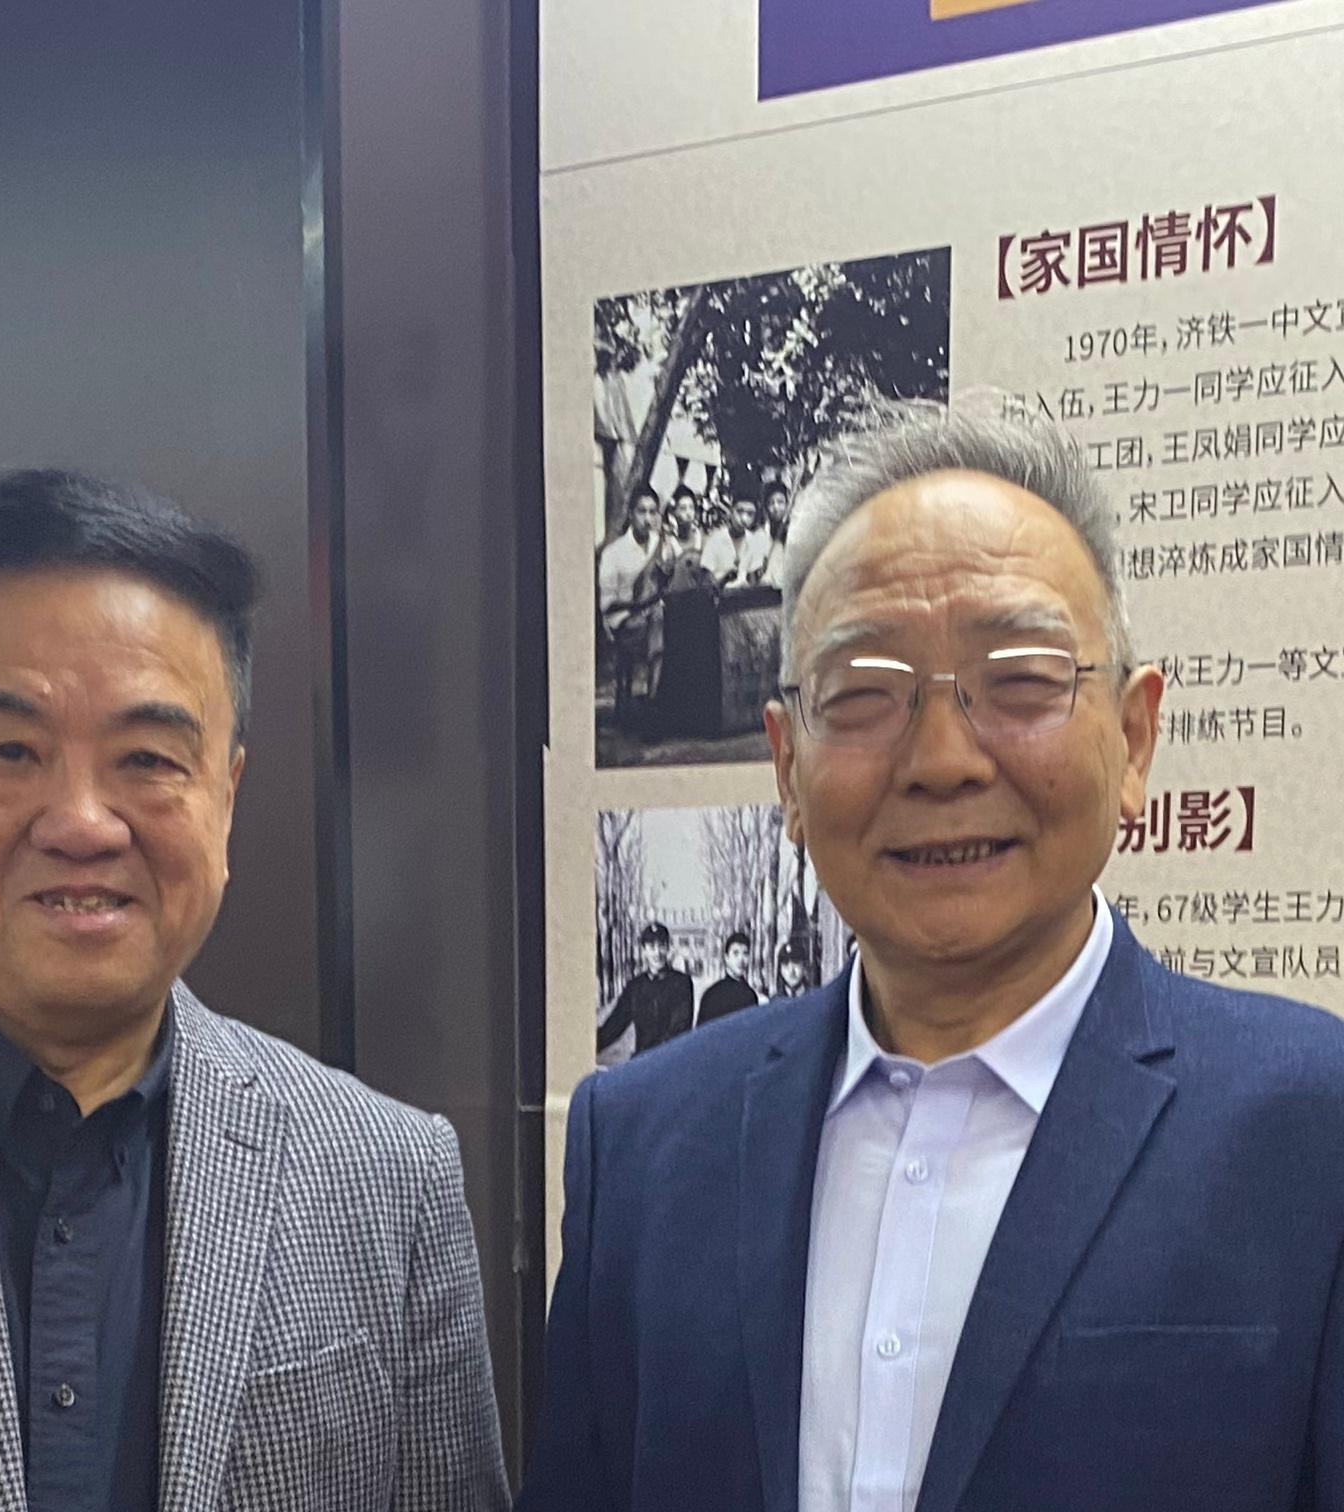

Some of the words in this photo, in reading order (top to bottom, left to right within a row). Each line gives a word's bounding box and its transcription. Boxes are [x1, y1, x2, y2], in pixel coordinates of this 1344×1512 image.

[998, 194, 1276, 300] 【家国情怀】
[1158, 707, 1303, 745] 排练节目。
